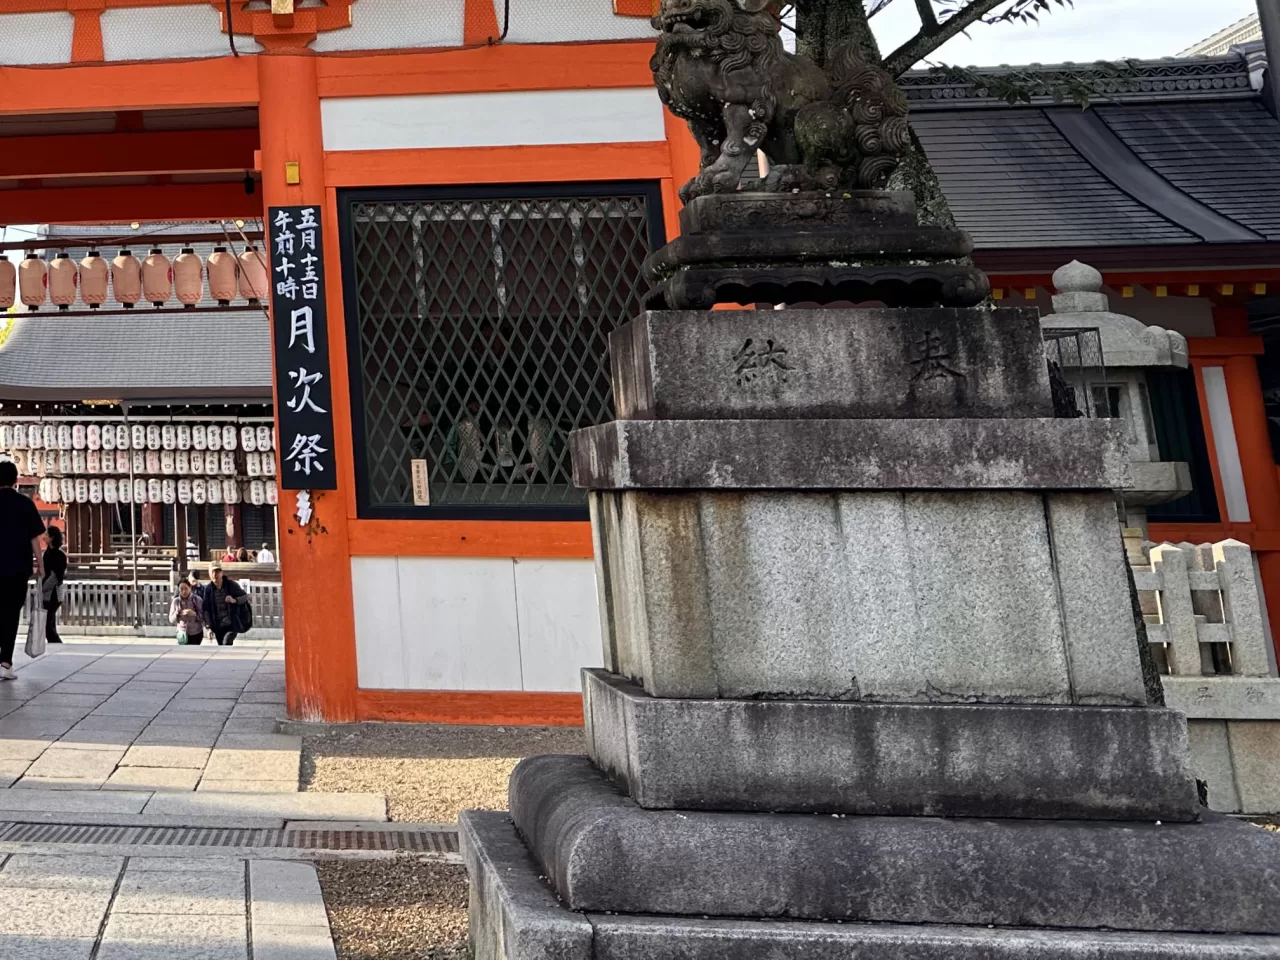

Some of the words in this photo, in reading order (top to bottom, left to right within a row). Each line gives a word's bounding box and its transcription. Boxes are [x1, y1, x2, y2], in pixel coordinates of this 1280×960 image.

[273, 209, 299, 301] 午前十時
[295, 207, 319, 300] 五月十五日
[284, 304, 329, 475] 月次祭
